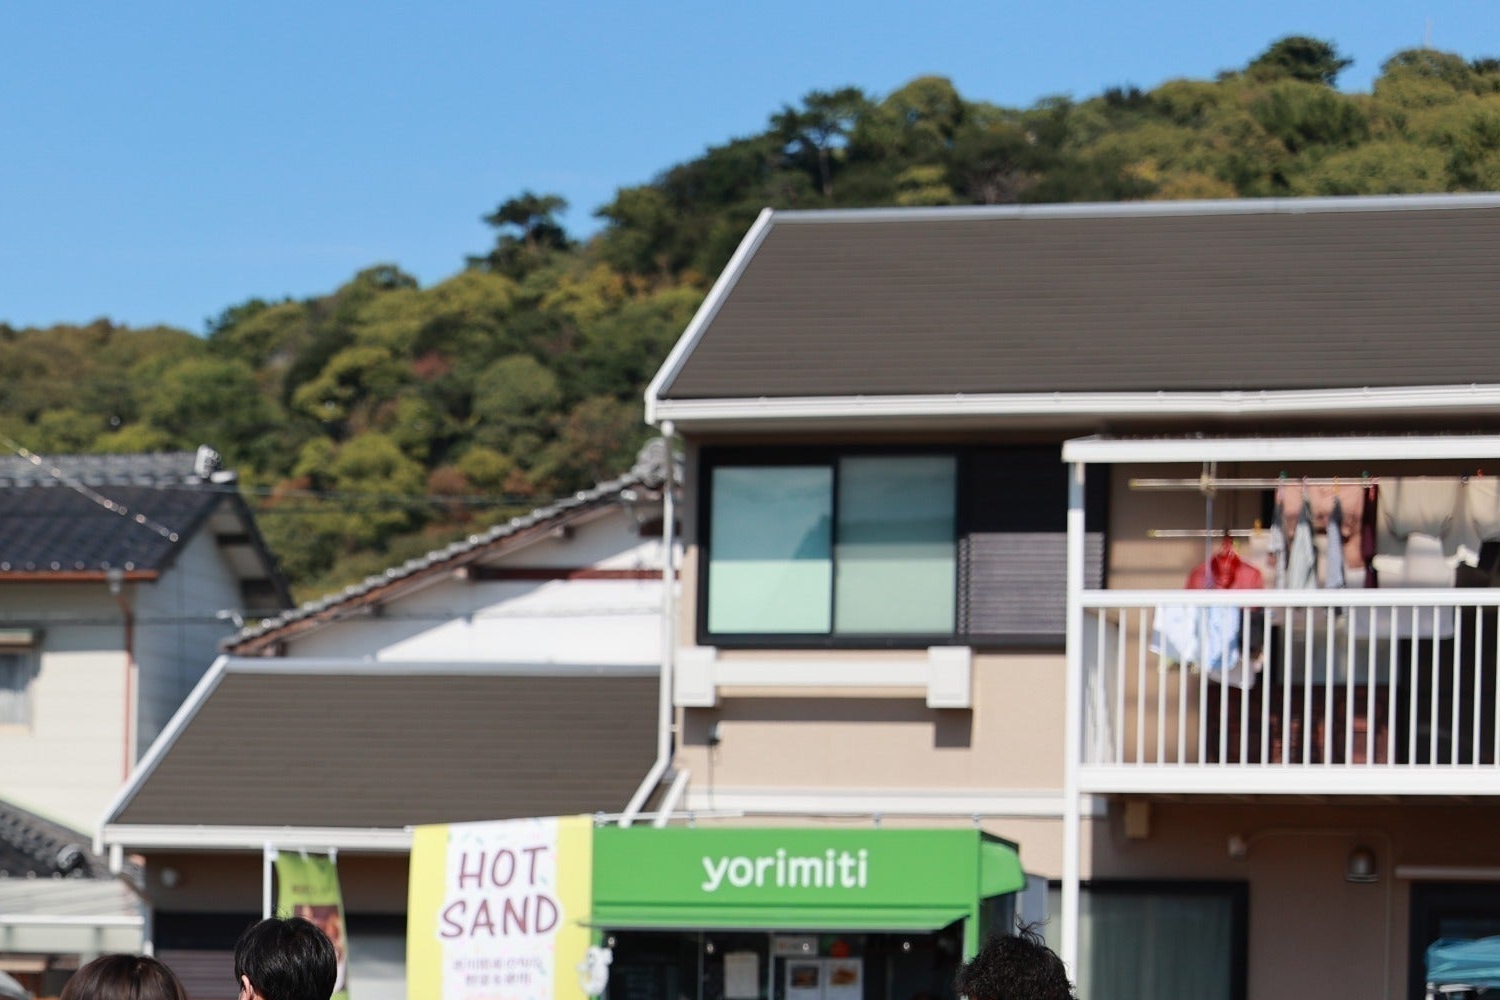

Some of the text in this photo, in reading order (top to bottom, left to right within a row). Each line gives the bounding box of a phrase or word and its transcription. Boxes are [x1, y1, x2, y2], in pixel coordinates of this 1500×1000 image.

[459, 846, 548, 889] HOT
[701, 848, 869, 892] yorimiti
[441, 895, 559, 938] SAND
